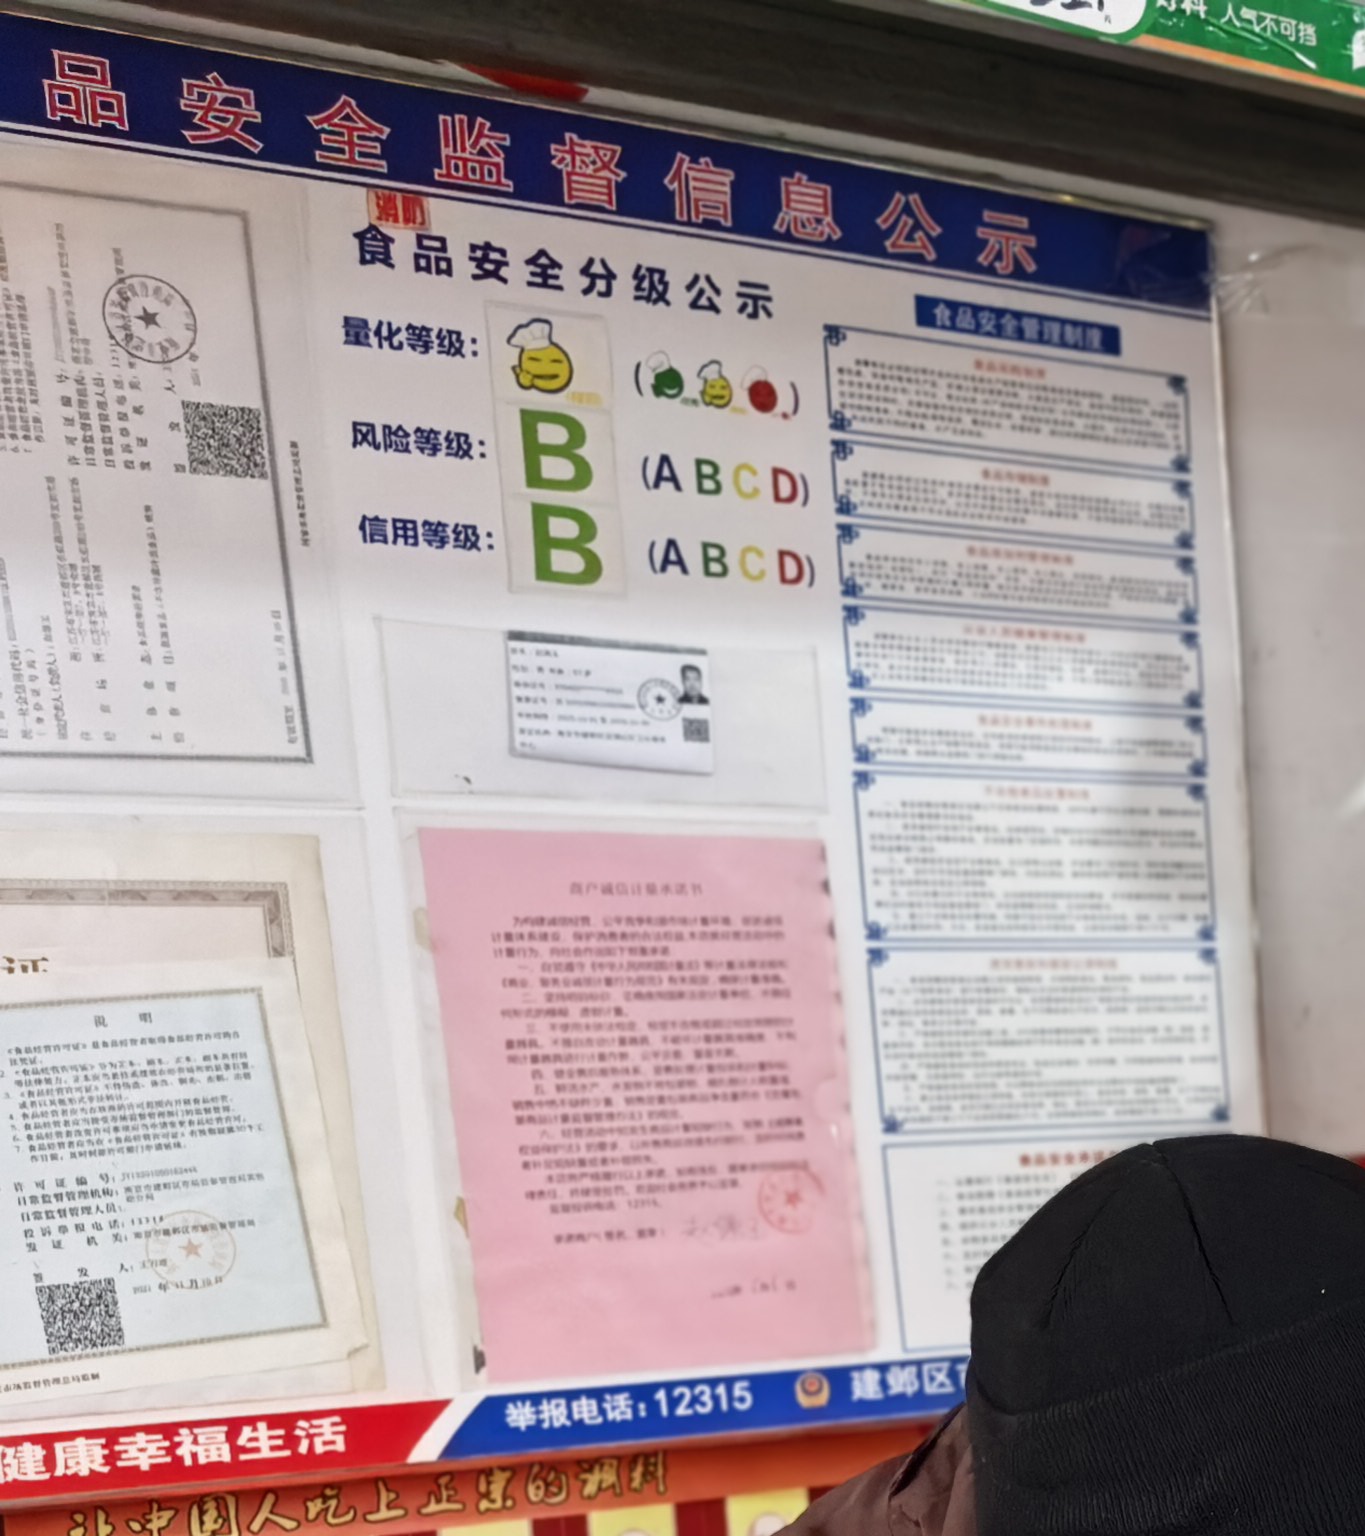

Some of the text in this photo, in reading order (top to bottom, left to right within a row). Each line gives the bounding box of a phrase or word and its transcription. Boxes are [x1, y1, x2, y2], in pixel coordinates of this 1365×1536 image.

[352, 224, 776, 321] 食品安全分级公示
[931, 301, 1104, 351] 食品安全管理制度
[519, 408, 594, 494] B
[530, 501, 604, 587] B
